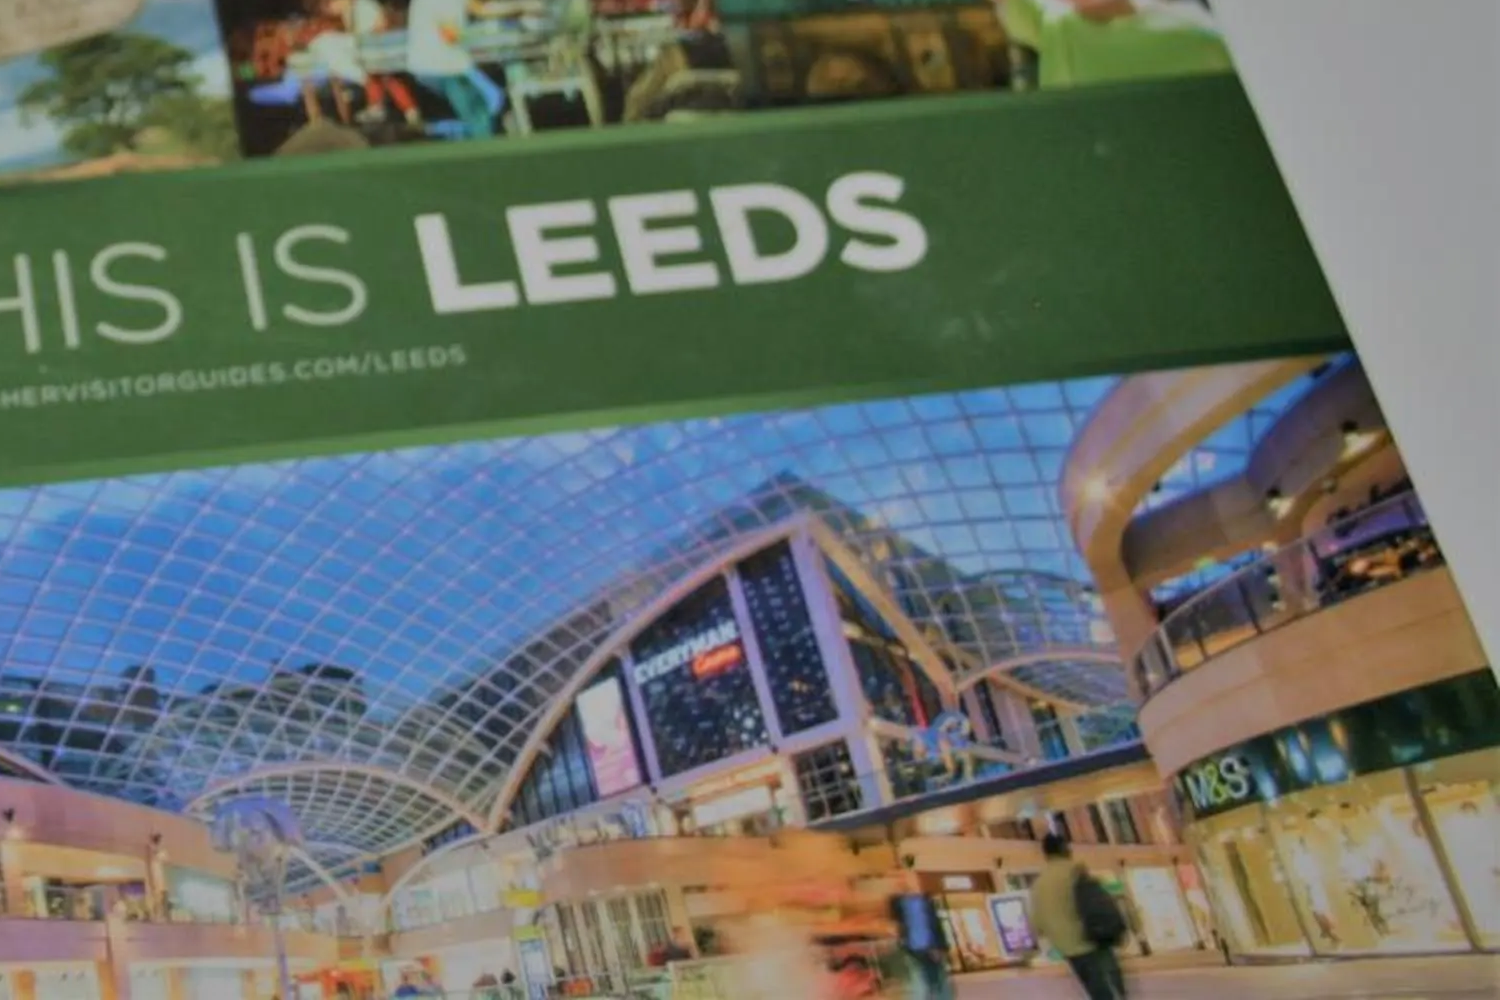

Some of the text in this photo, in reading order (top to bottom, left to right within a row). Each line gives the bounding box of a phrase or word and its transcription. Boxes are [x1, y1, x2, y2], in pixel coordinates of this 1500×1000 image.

[236, 223, 368, 332] IS
[413, 171, 929, 316] LEEDS
[1185, 756, 1249, 809] M&S
